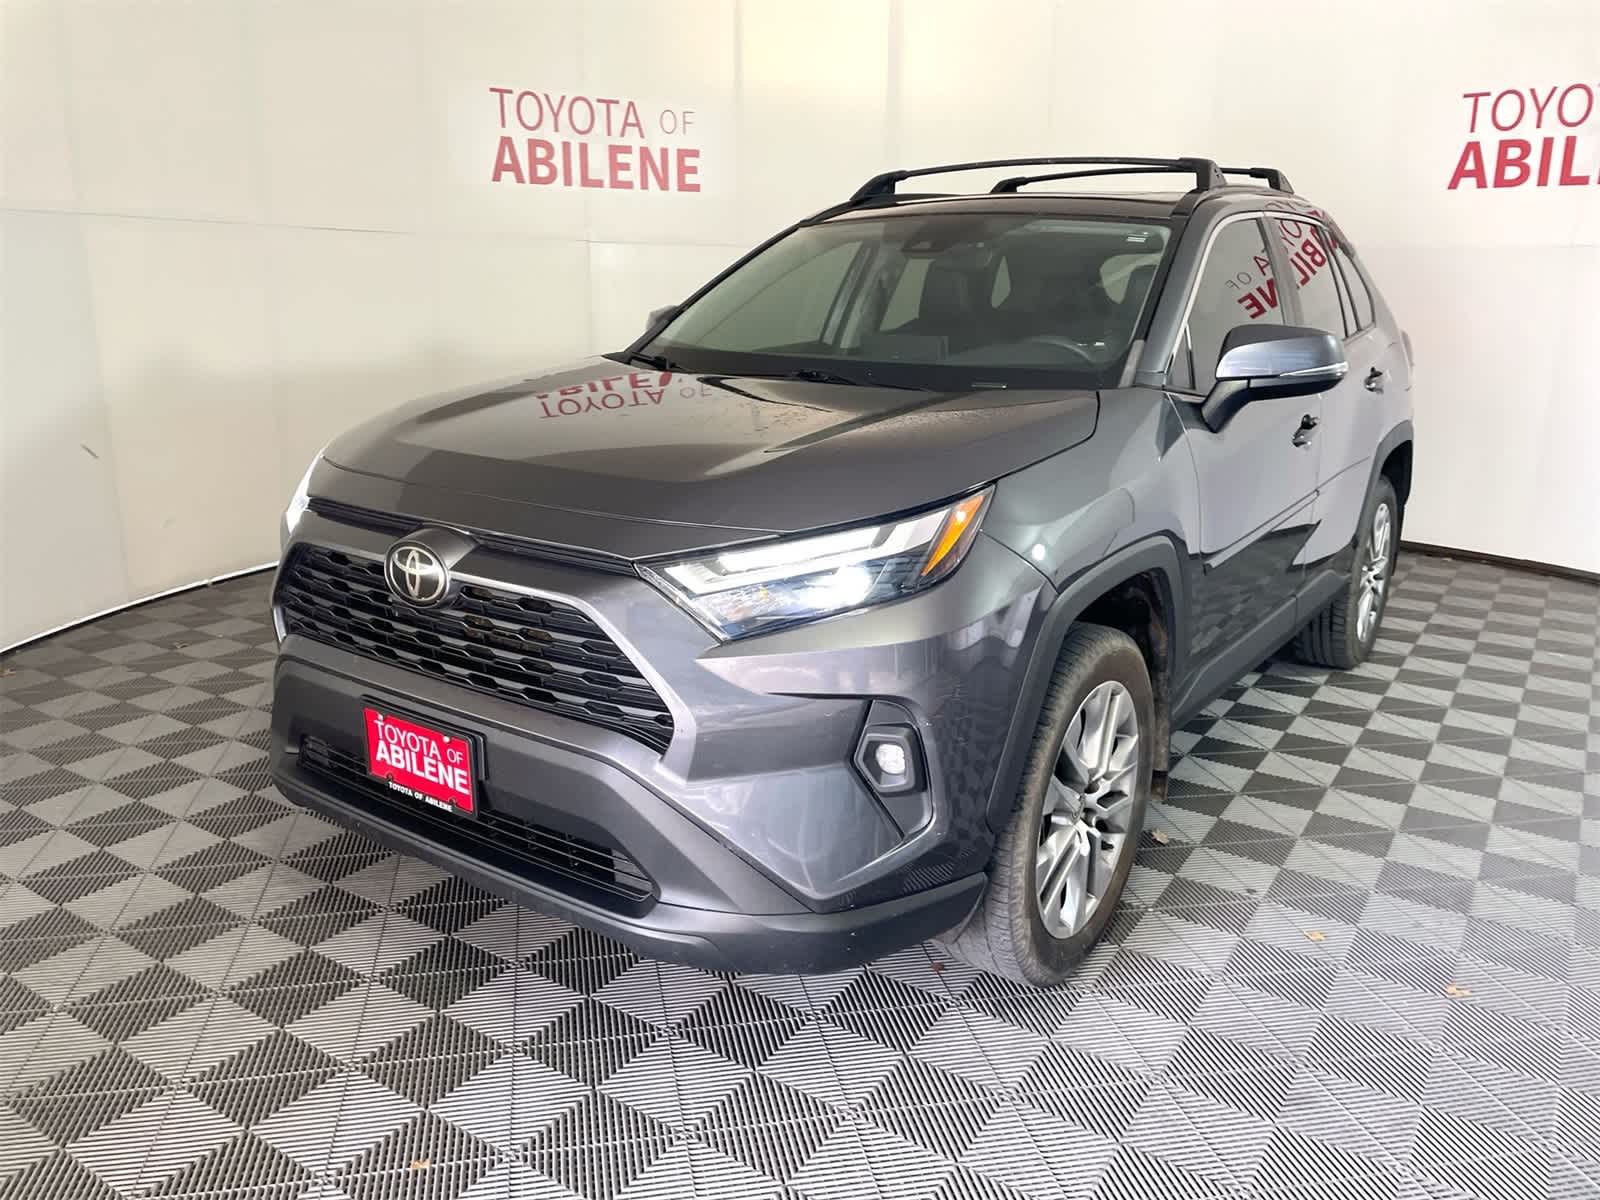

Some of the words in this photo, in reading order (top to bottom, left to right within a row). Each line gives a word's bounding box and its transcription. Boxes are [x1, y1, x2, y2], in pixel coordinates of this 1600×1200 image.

[489, 87, 645, 139] TOYOTA
[659, 109, 696, 135] OF
[1462, 82, 1600, 133] TOYO
[491, 135, 701, 193] ABILENE
[1447, 135, 1600, 190] ABIL
[374, 719, 441, 761] TOYOTA
[447, 748, 463, 764] OF
[375, 740, 470, 795] ABILENE
[388, 781, 413, 797] TOYOTA
[414, 791, 423, 800] OF
[425, 796, 453, 812] ABILENE
